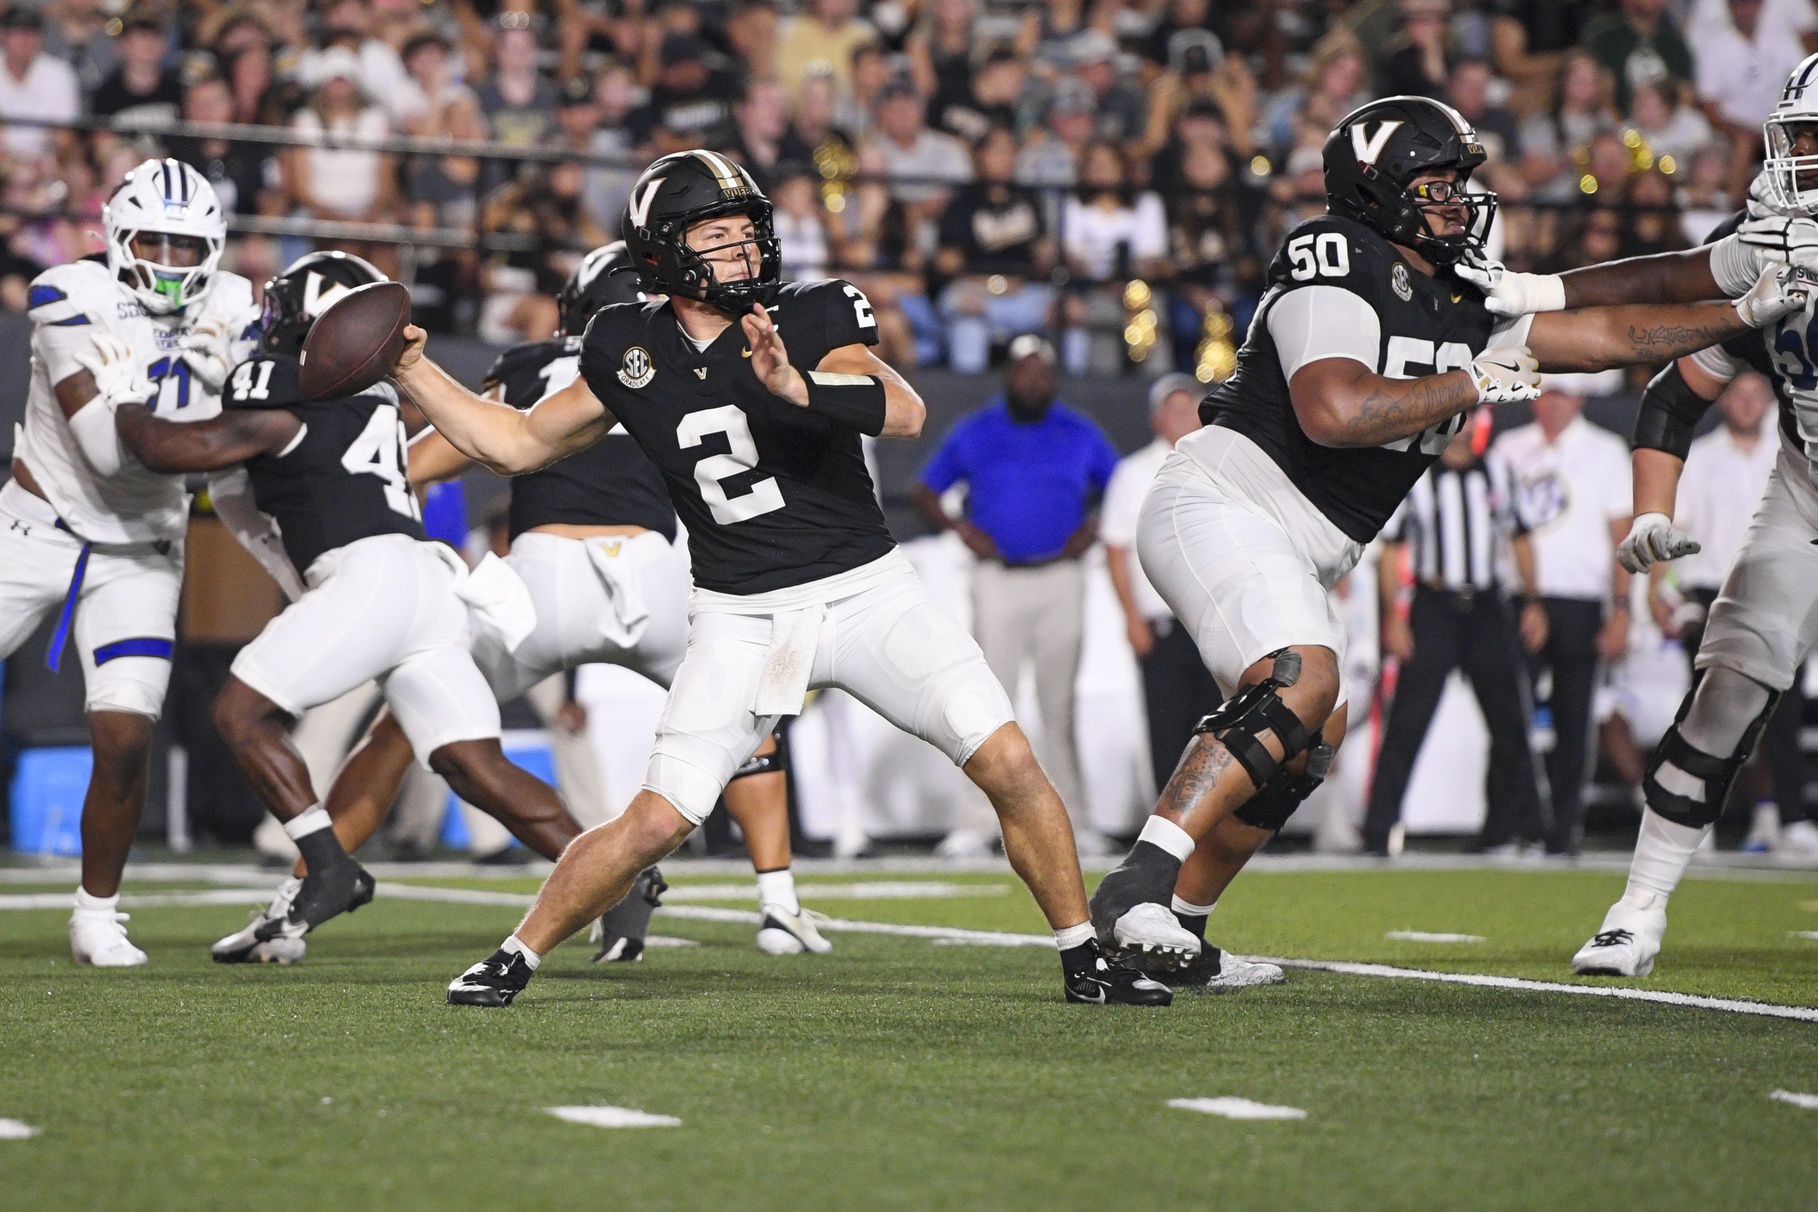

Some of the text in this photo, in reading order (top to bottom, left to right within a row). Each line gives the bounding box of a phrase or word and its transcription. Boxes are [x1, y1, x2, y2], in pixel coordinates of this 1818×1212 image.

[1288, 232, 1350, 281] 50
[842, 285, 877, 328] 2
[231, 361, 276, 401] 41
[620, 375, 651, 388] GRADUATE
[625, 349, 648, 378] SEC
[676, 404, 786, 525] 2
